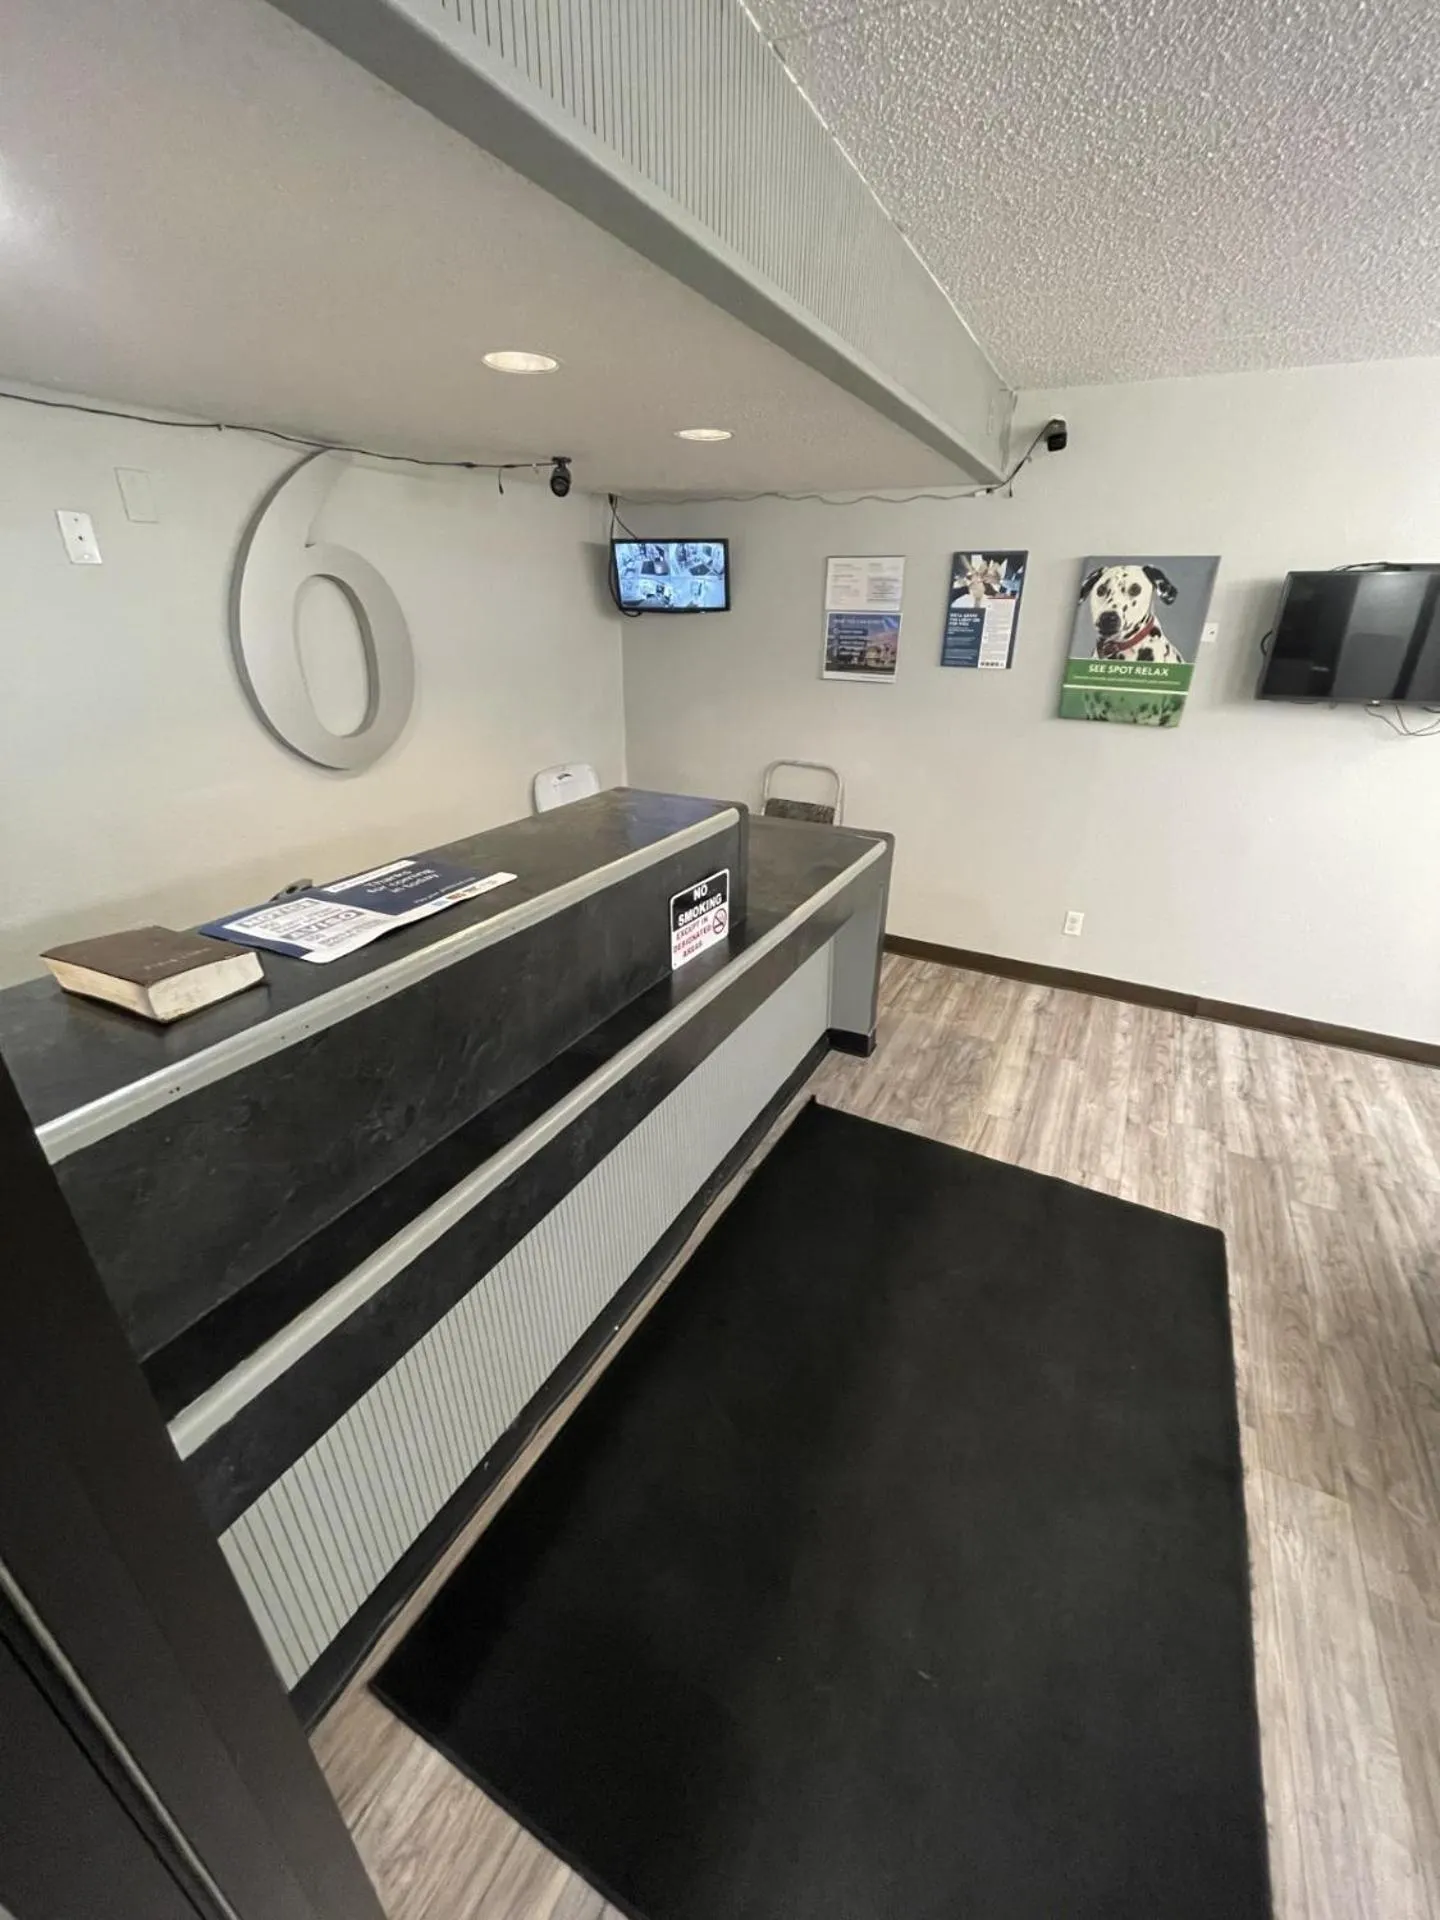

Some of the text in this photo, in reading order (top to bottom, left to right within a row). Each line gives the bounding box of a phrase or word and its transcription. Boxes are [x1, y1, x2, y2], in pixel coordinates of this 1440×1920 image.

[228, 447, 415, 772] 6
[1088, 664, 1170, 677] SEE SPOT RELAX
[693, 884, 707, 900] NO
[678, 893, 722, 926] SMOKING
